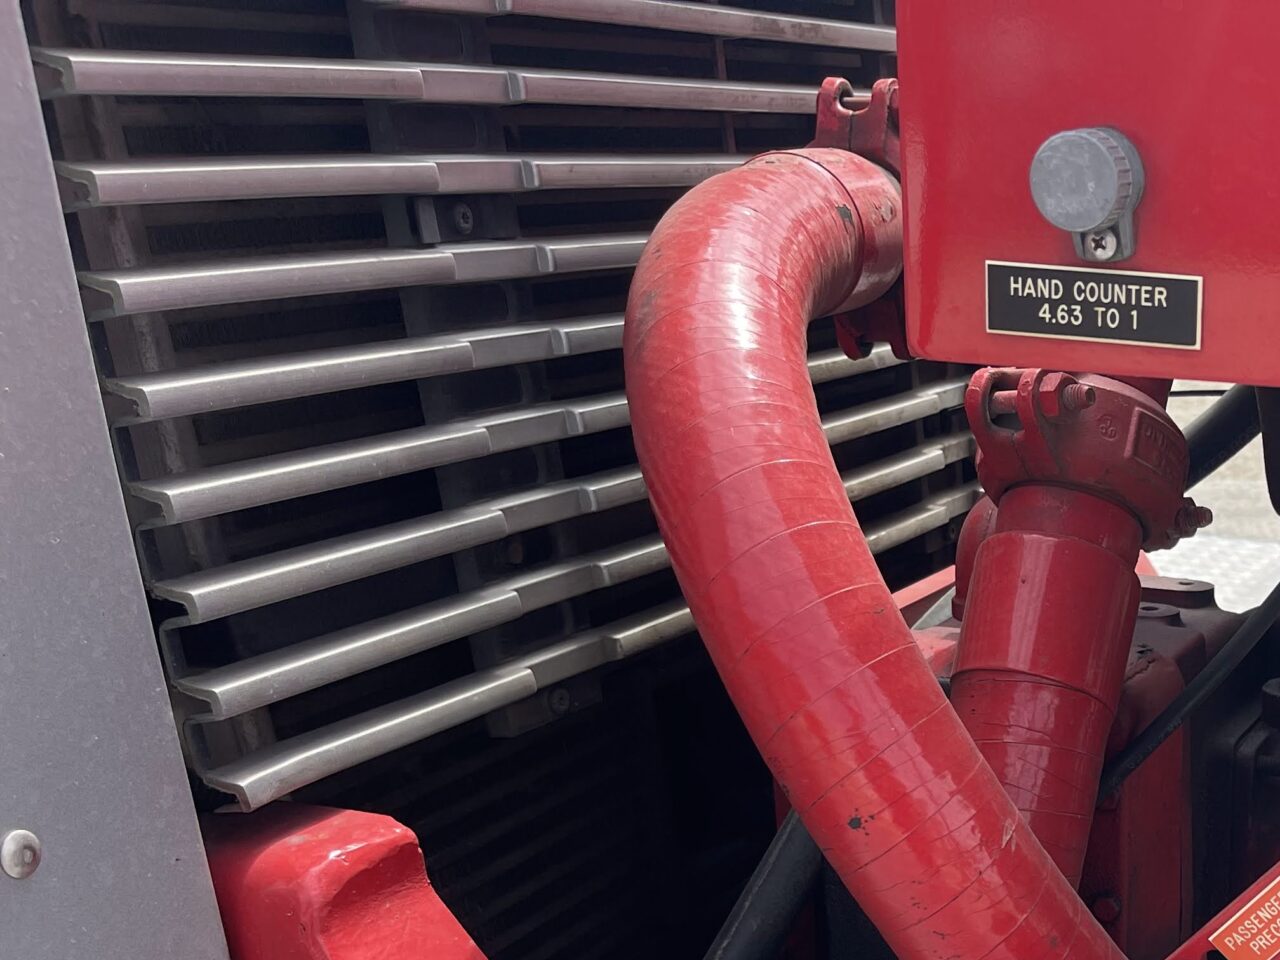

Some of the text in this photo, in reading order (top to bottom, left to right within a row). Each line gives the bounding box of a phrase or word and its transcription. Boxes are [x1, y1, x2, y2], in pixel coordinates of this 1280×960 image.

[1009, 275, 1168, 308] HAND COUNTER
[1038, 303, 1139, 331] 4.63 TO 1
